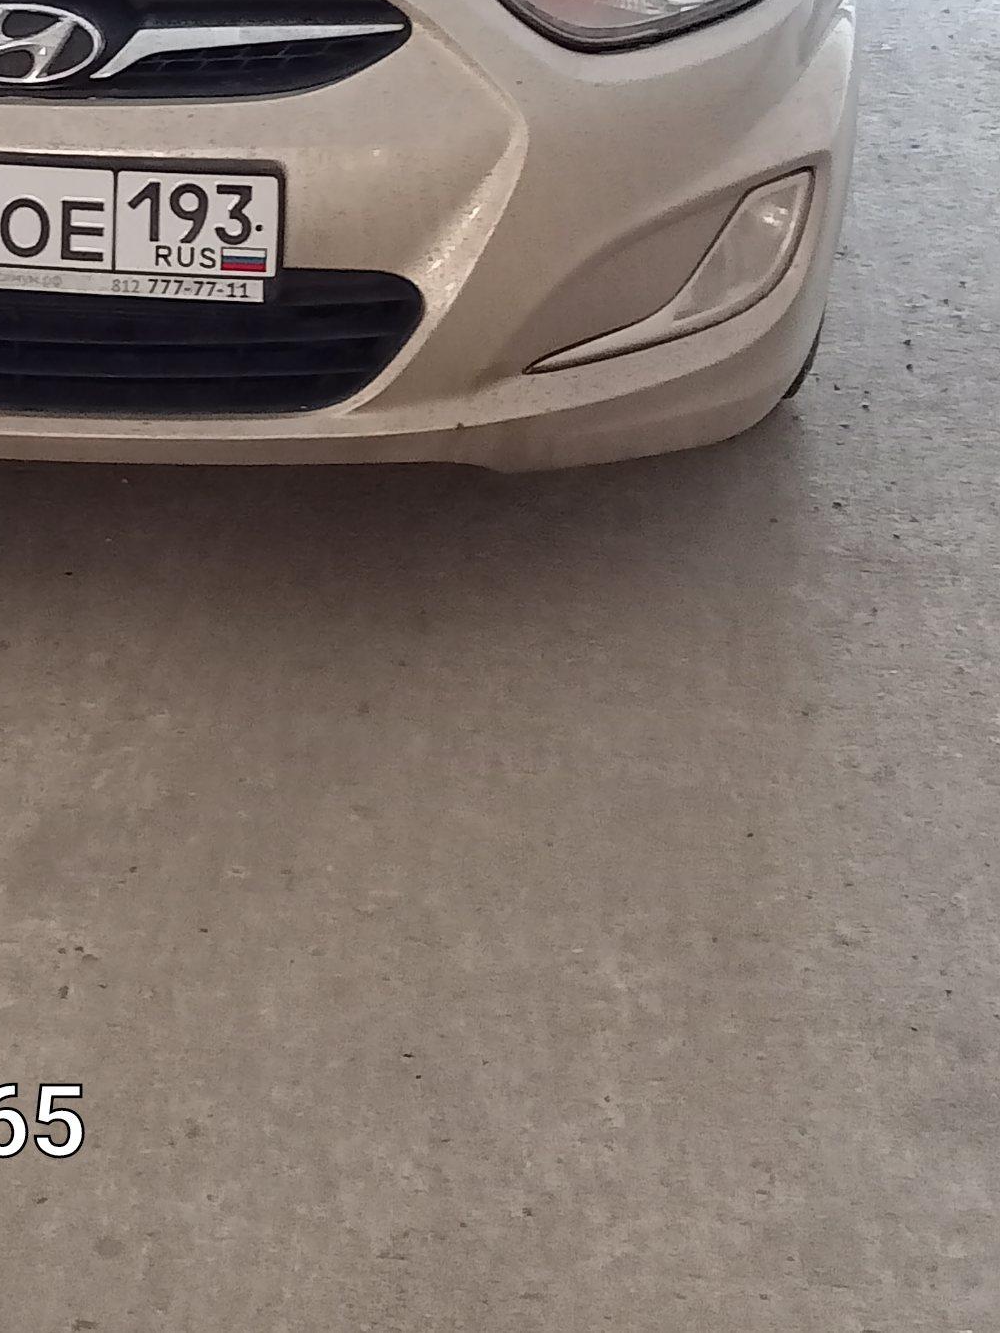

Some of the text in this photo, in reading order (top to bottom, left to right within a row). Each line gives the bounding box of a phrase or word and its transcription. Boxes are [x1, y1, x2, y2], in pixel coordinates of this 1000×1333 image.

[127, 182, 253, 246] 193
[154, 244, 217, 269] RUS
[110, 277, 251, 299] 812 777-77-11
